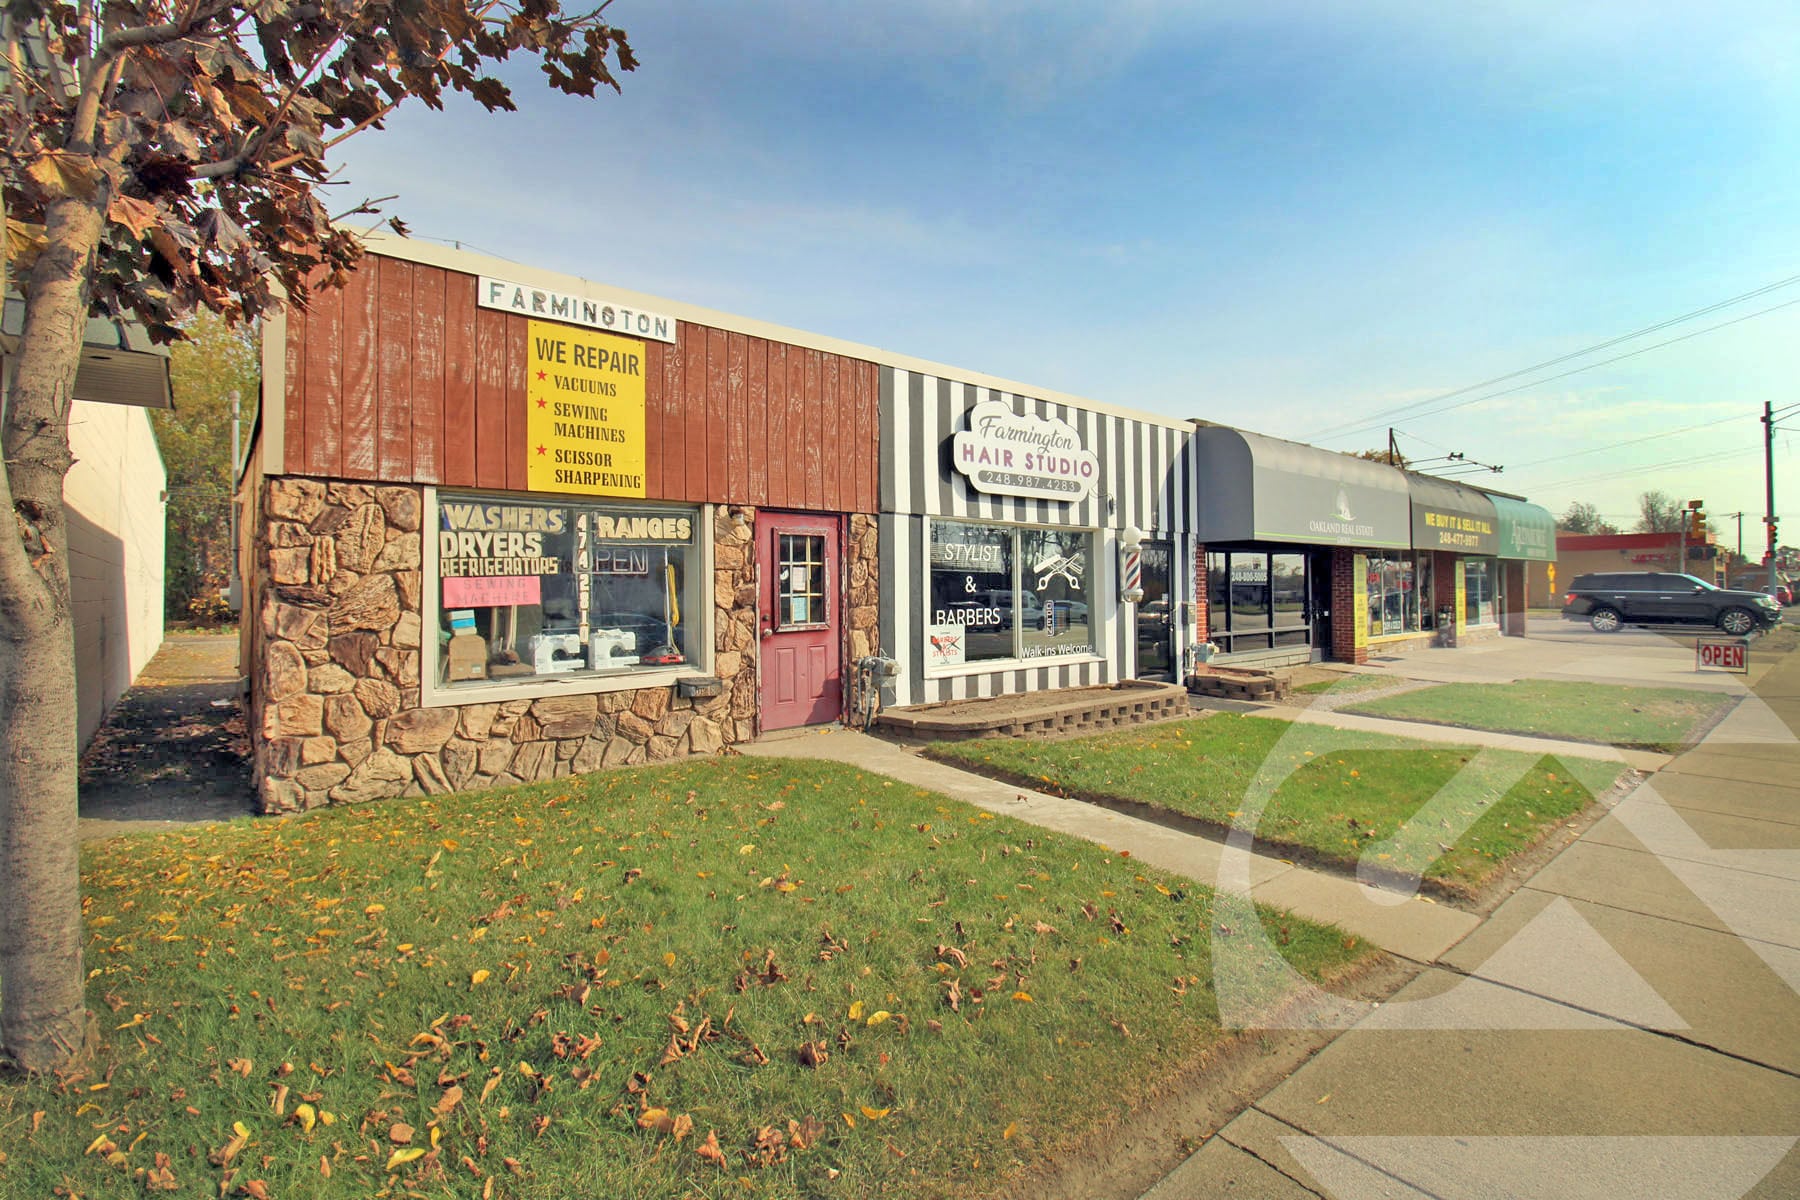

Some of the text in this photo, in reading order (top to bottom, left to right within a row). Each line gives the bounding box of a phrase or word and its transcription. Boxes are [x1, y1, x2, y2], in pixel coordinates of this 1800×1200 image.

[490, 282, 667, 338] FARMINGTON
[535, 337, 640, 377] WE REPAIR
[554, 375, 617, 397] VACUUMS
[554, 402, 608, 422] SEWING
[554, 422, 625, 443] MACHINES
[979, 415, 1073, 454] Farmington
[555, 449, 612, 467] SCISSOR
[962, 443, 1093, 478] HAIR STUDIO
[555, 469, 641, 489] SHARPENING
[986, 471, 1076, 491] 248.987.4283
[444, 504, 563, 535] WASHERS
[598, 516, 691, 540] RANGES
[1309, 520, 1374, 537] OAKLAND REAL ESTATE
[1425, 512, 1436, 527] WE
[1436, 514, 1449, 528] BUY
[1449, 516, 1457, 529] IT
[1462, 518, 1475, 532] SELL
[440, 531, 542, 558] DRYERS
[944, 543, 1001, 562] STYLIST
[440, 557, 559, 577] REFRIGERATORS
[463, 578, 526, 590] SEWING
[965, 575, 977, 593] &
[936, 607, 1001, 626] BARBERS
[1021, 643, 1093, 658] Walk-ins Welcome
[1702, 645, 1744, 667] OPEN
